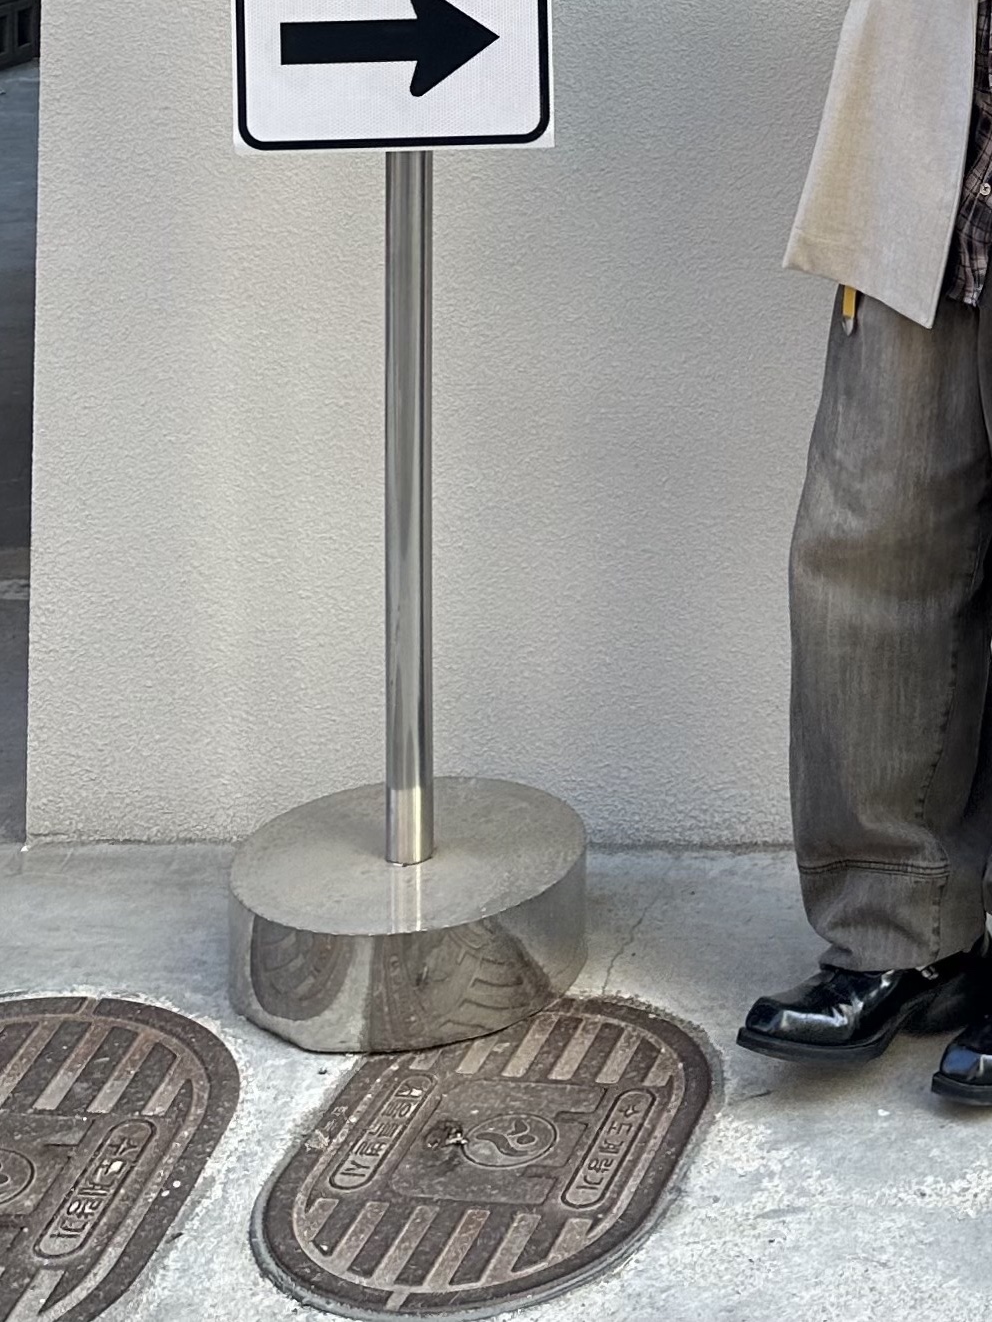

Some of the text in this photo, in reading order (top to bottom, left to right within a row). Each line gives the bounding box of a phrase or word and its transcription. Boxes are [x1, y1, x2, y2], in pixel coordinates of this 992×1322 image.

[340, 1082, 423, 1177] 서울특별시
[576, 1104, 640, 1190] 수도계량기
[50, 1136, 138, 1239] 수도계량기
